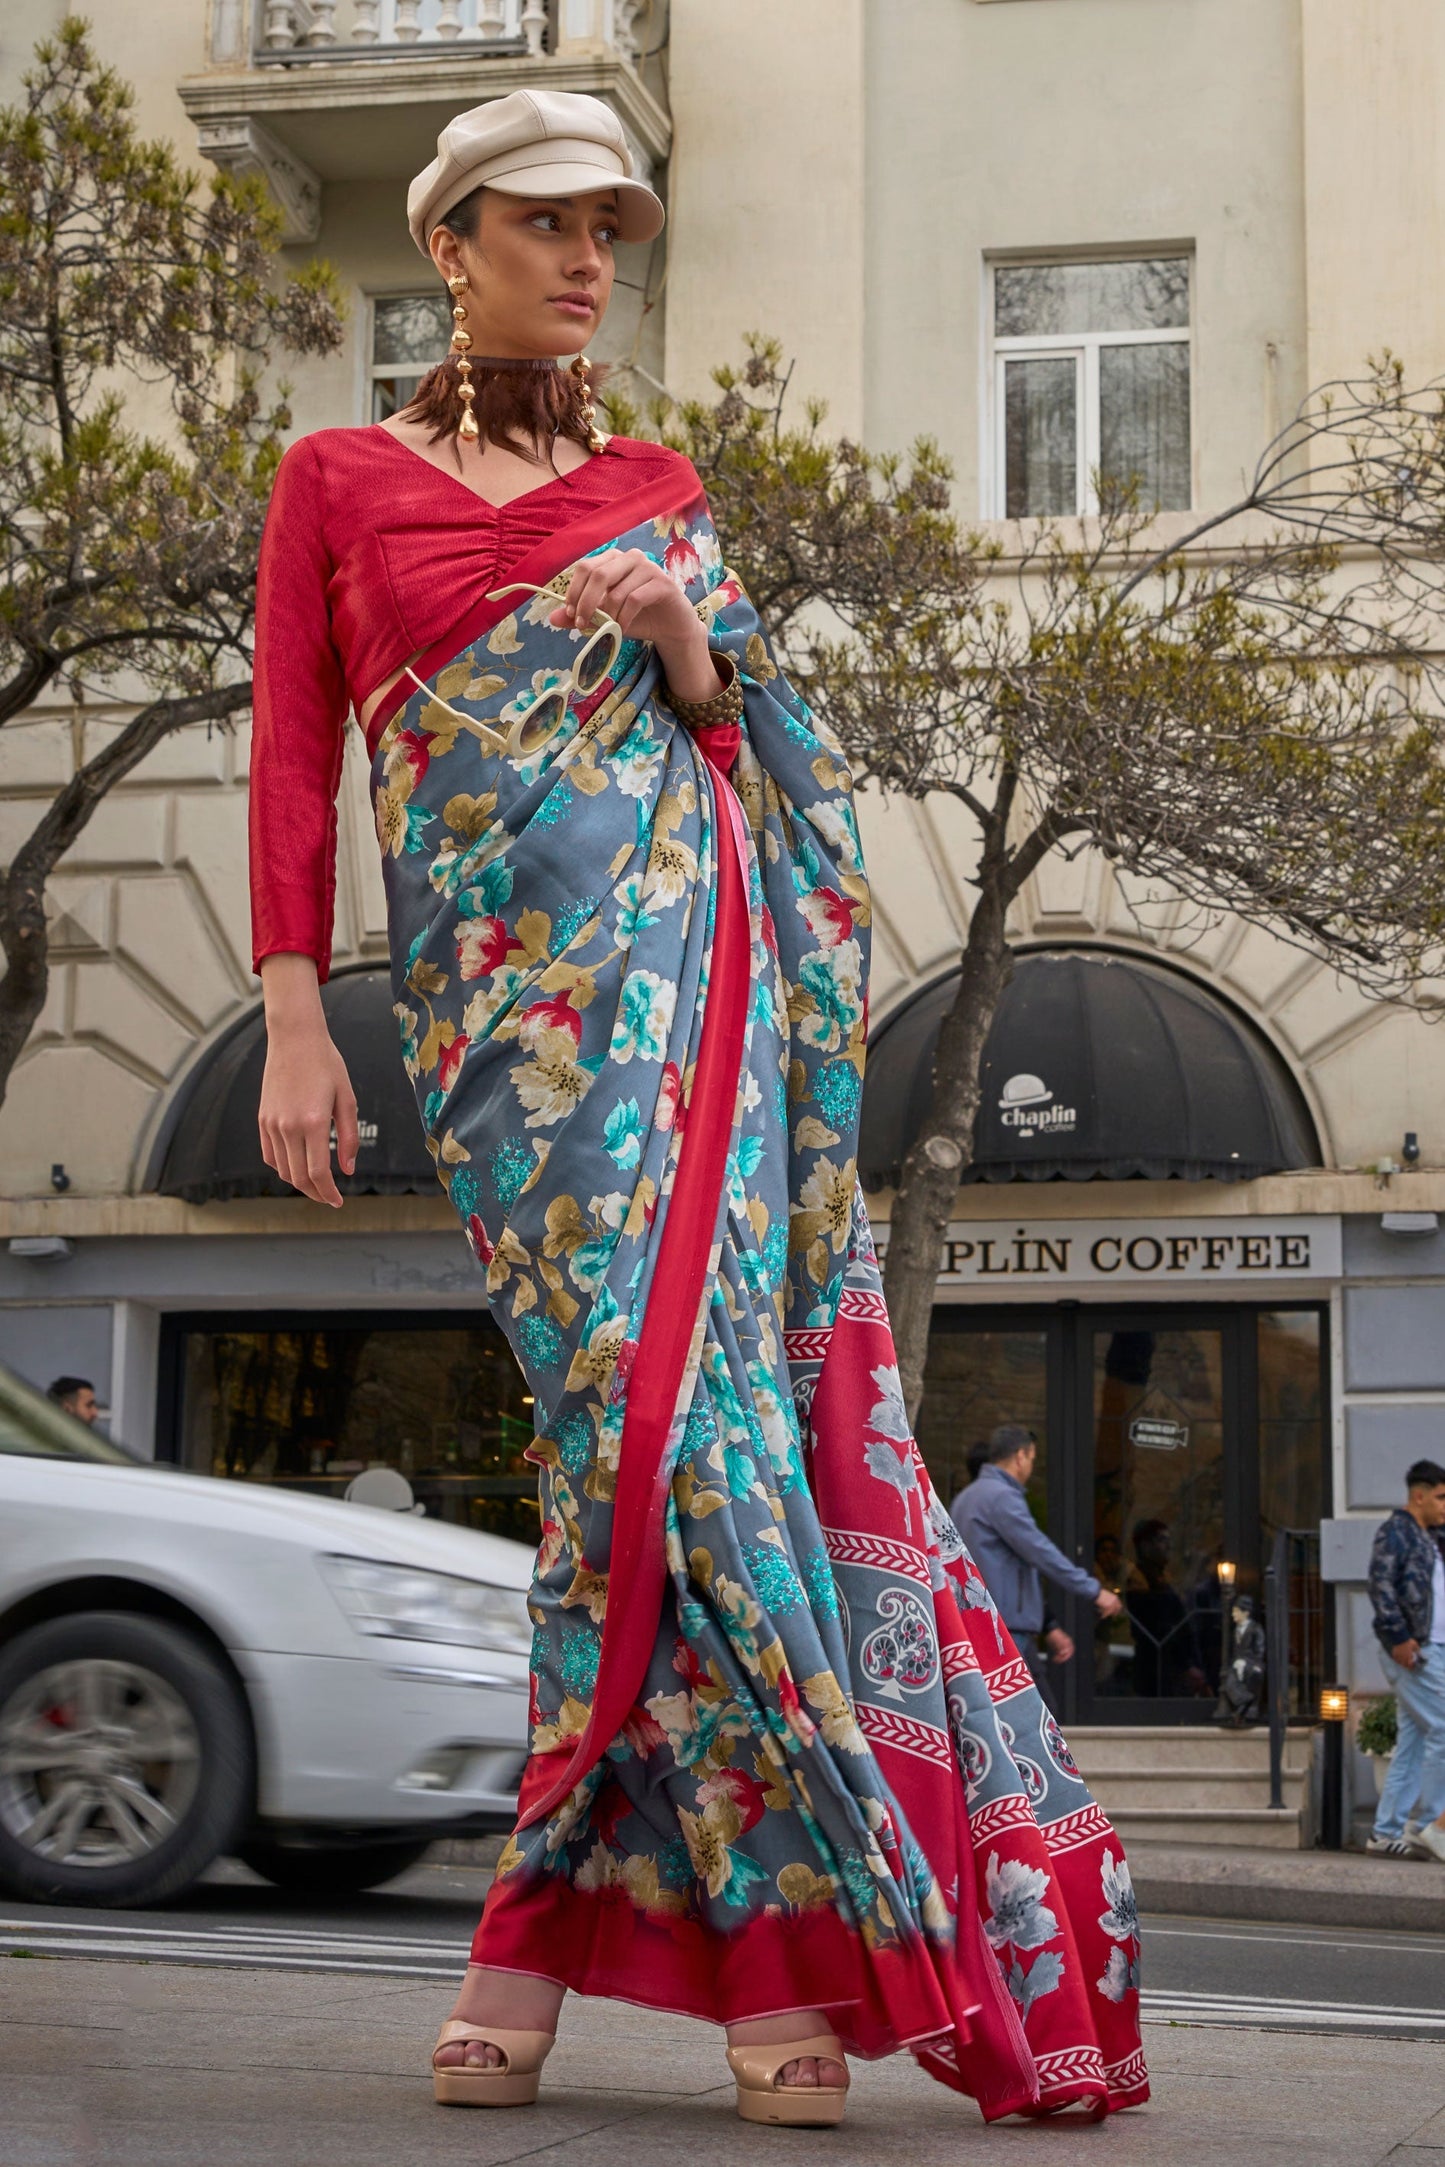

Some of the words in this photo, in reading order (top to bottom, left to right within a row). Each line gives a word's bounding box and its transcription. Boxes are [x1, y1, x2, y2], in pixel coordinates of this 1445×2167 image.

[1001, 1104, 1077, 1130] chaplin
[875, 1228, 1071, 1274] PLİN
[1090, 1234, 1311, 1273] COFFEE
